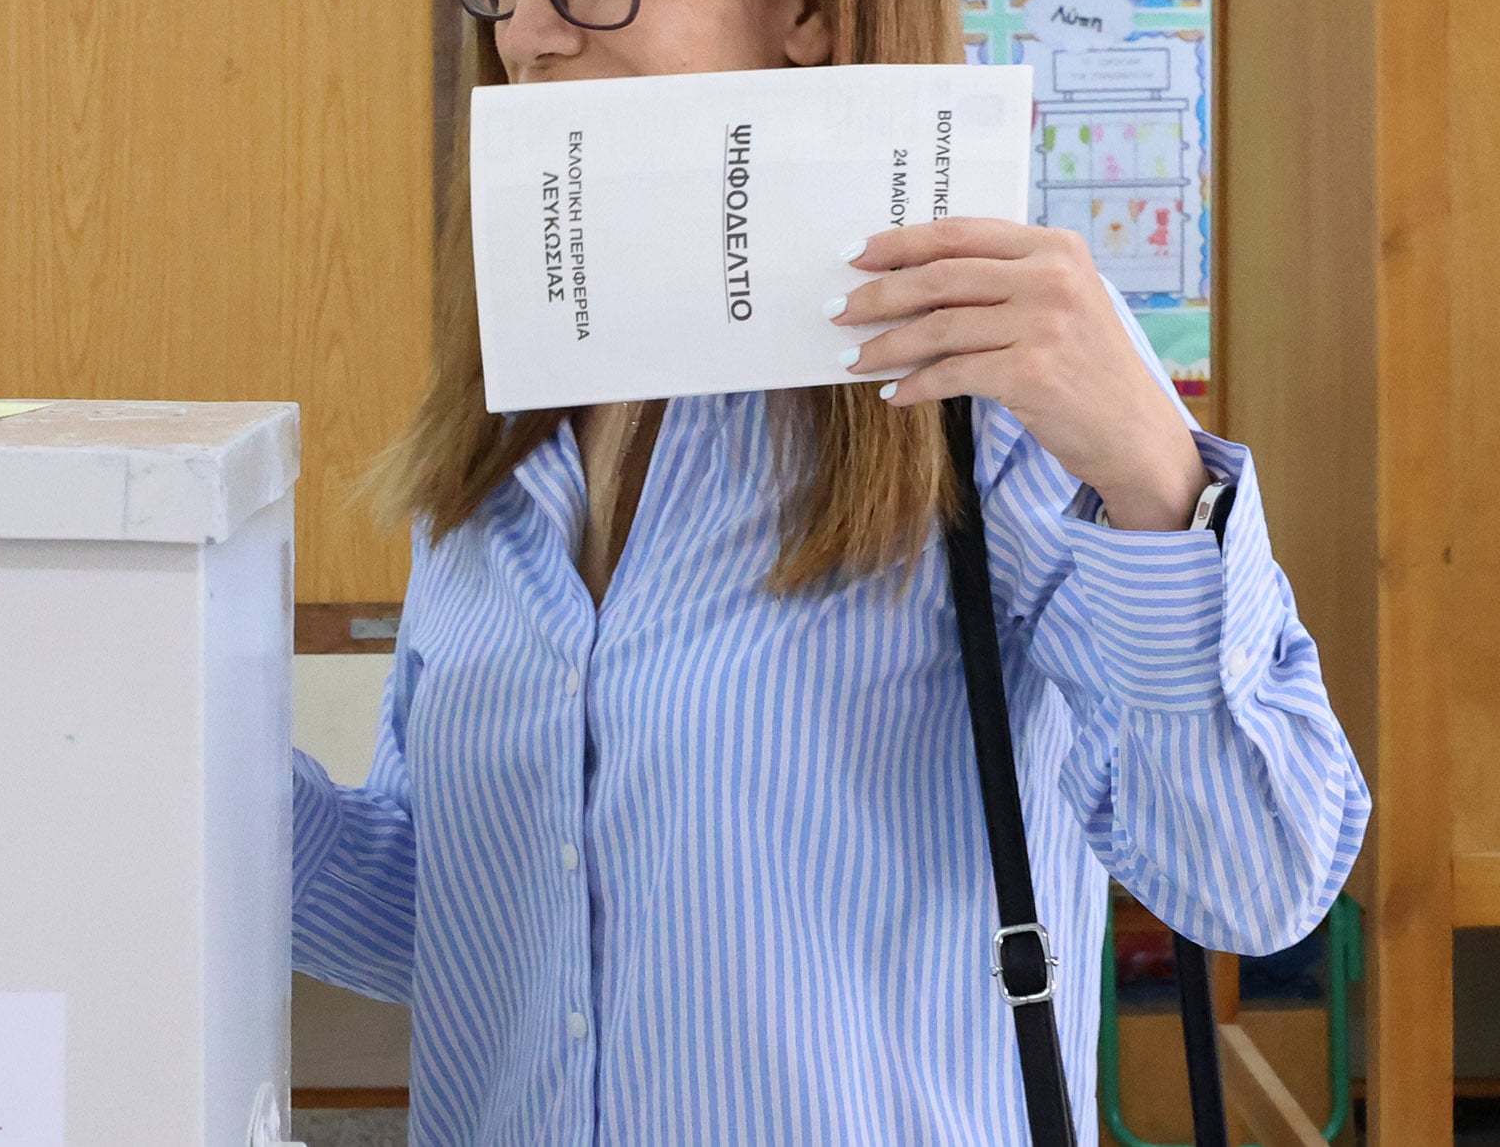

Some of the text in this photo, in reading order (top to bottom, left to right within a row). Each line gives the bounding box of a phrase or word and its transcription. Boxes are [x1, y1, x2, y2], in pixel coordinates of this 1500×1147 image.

[726, 124, 752, 321] ΨΗΦΟΔΕΛΤΙΟ
[890, 149, 910, 227] 24 ΜΑΪΟΥ
[933, 110, 952, 221] ΒΟΥΛΕΥΤΙΚΕ
[543, 172, 564, 303] ΛΕΥΚΩΣΙΑΣ
[568, 131, 590, 341] ΕΚΛΟΓΙΚΗ ΠΕΡΙΦΕΡΕΙΑ
